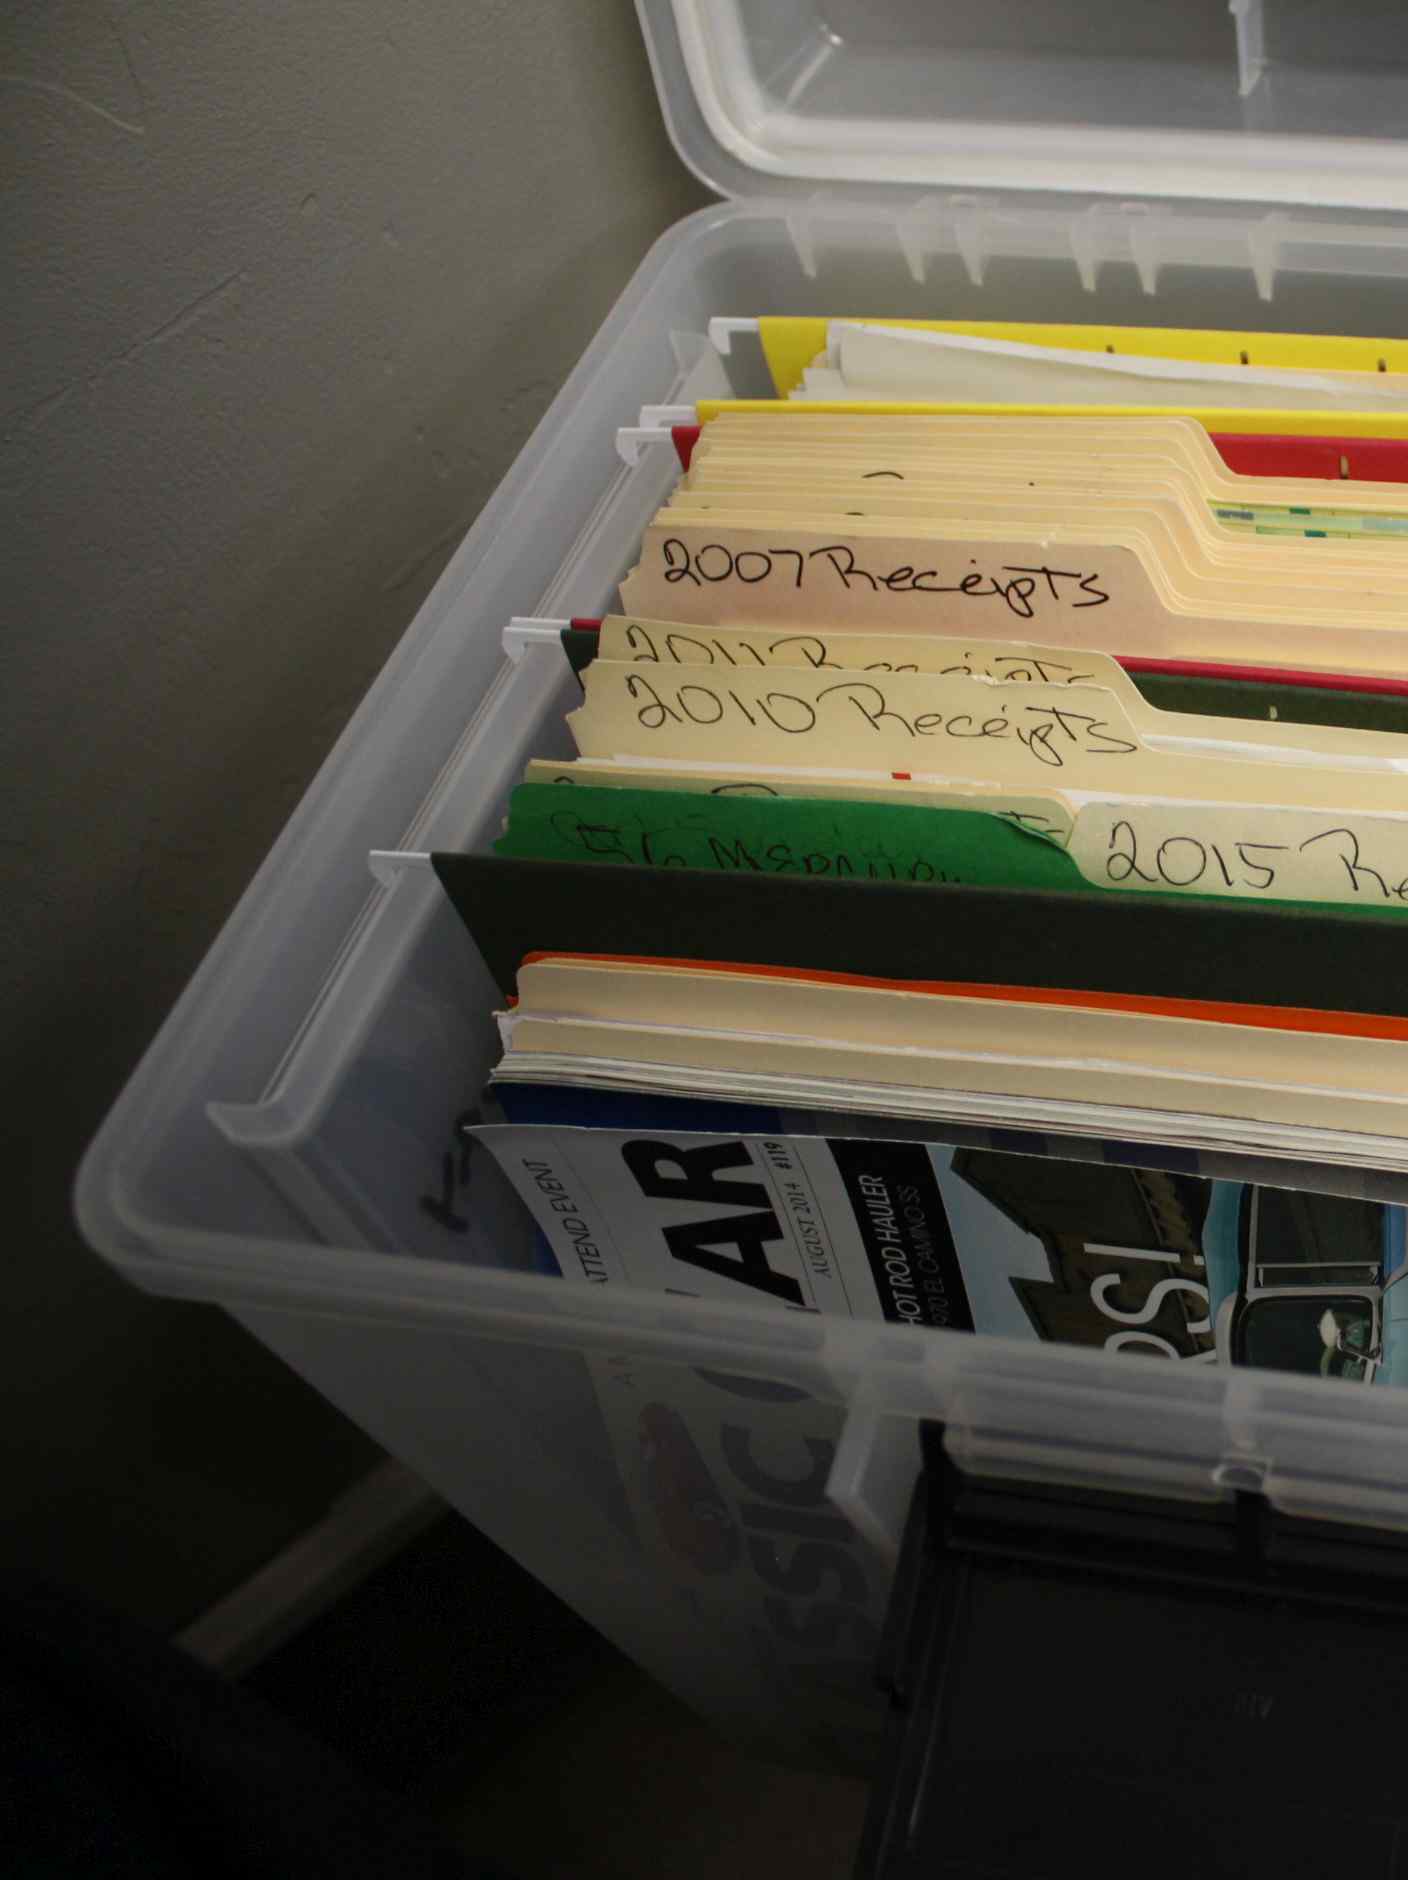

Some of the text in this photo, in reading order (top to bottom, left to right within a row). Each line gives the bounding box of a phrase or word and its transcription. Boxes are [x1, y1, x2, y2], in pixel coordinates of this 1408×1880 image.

[663, 539, 1110, 618] 2007 Receipts
[626, 675, 1137, 767] 2010 Receipts
[1106, 821, 1289, 890] 2015
[522, 1159, 578, 1213] EVENT
[784, 1182, 810, 1214] 2014
[858, 1173, 902, 1242] HAULER
[621, 1139, 806, 1308] AR
[799, 1217, 832, 1279] AUGUST
[881, 1247, 914, 1288] ROD
